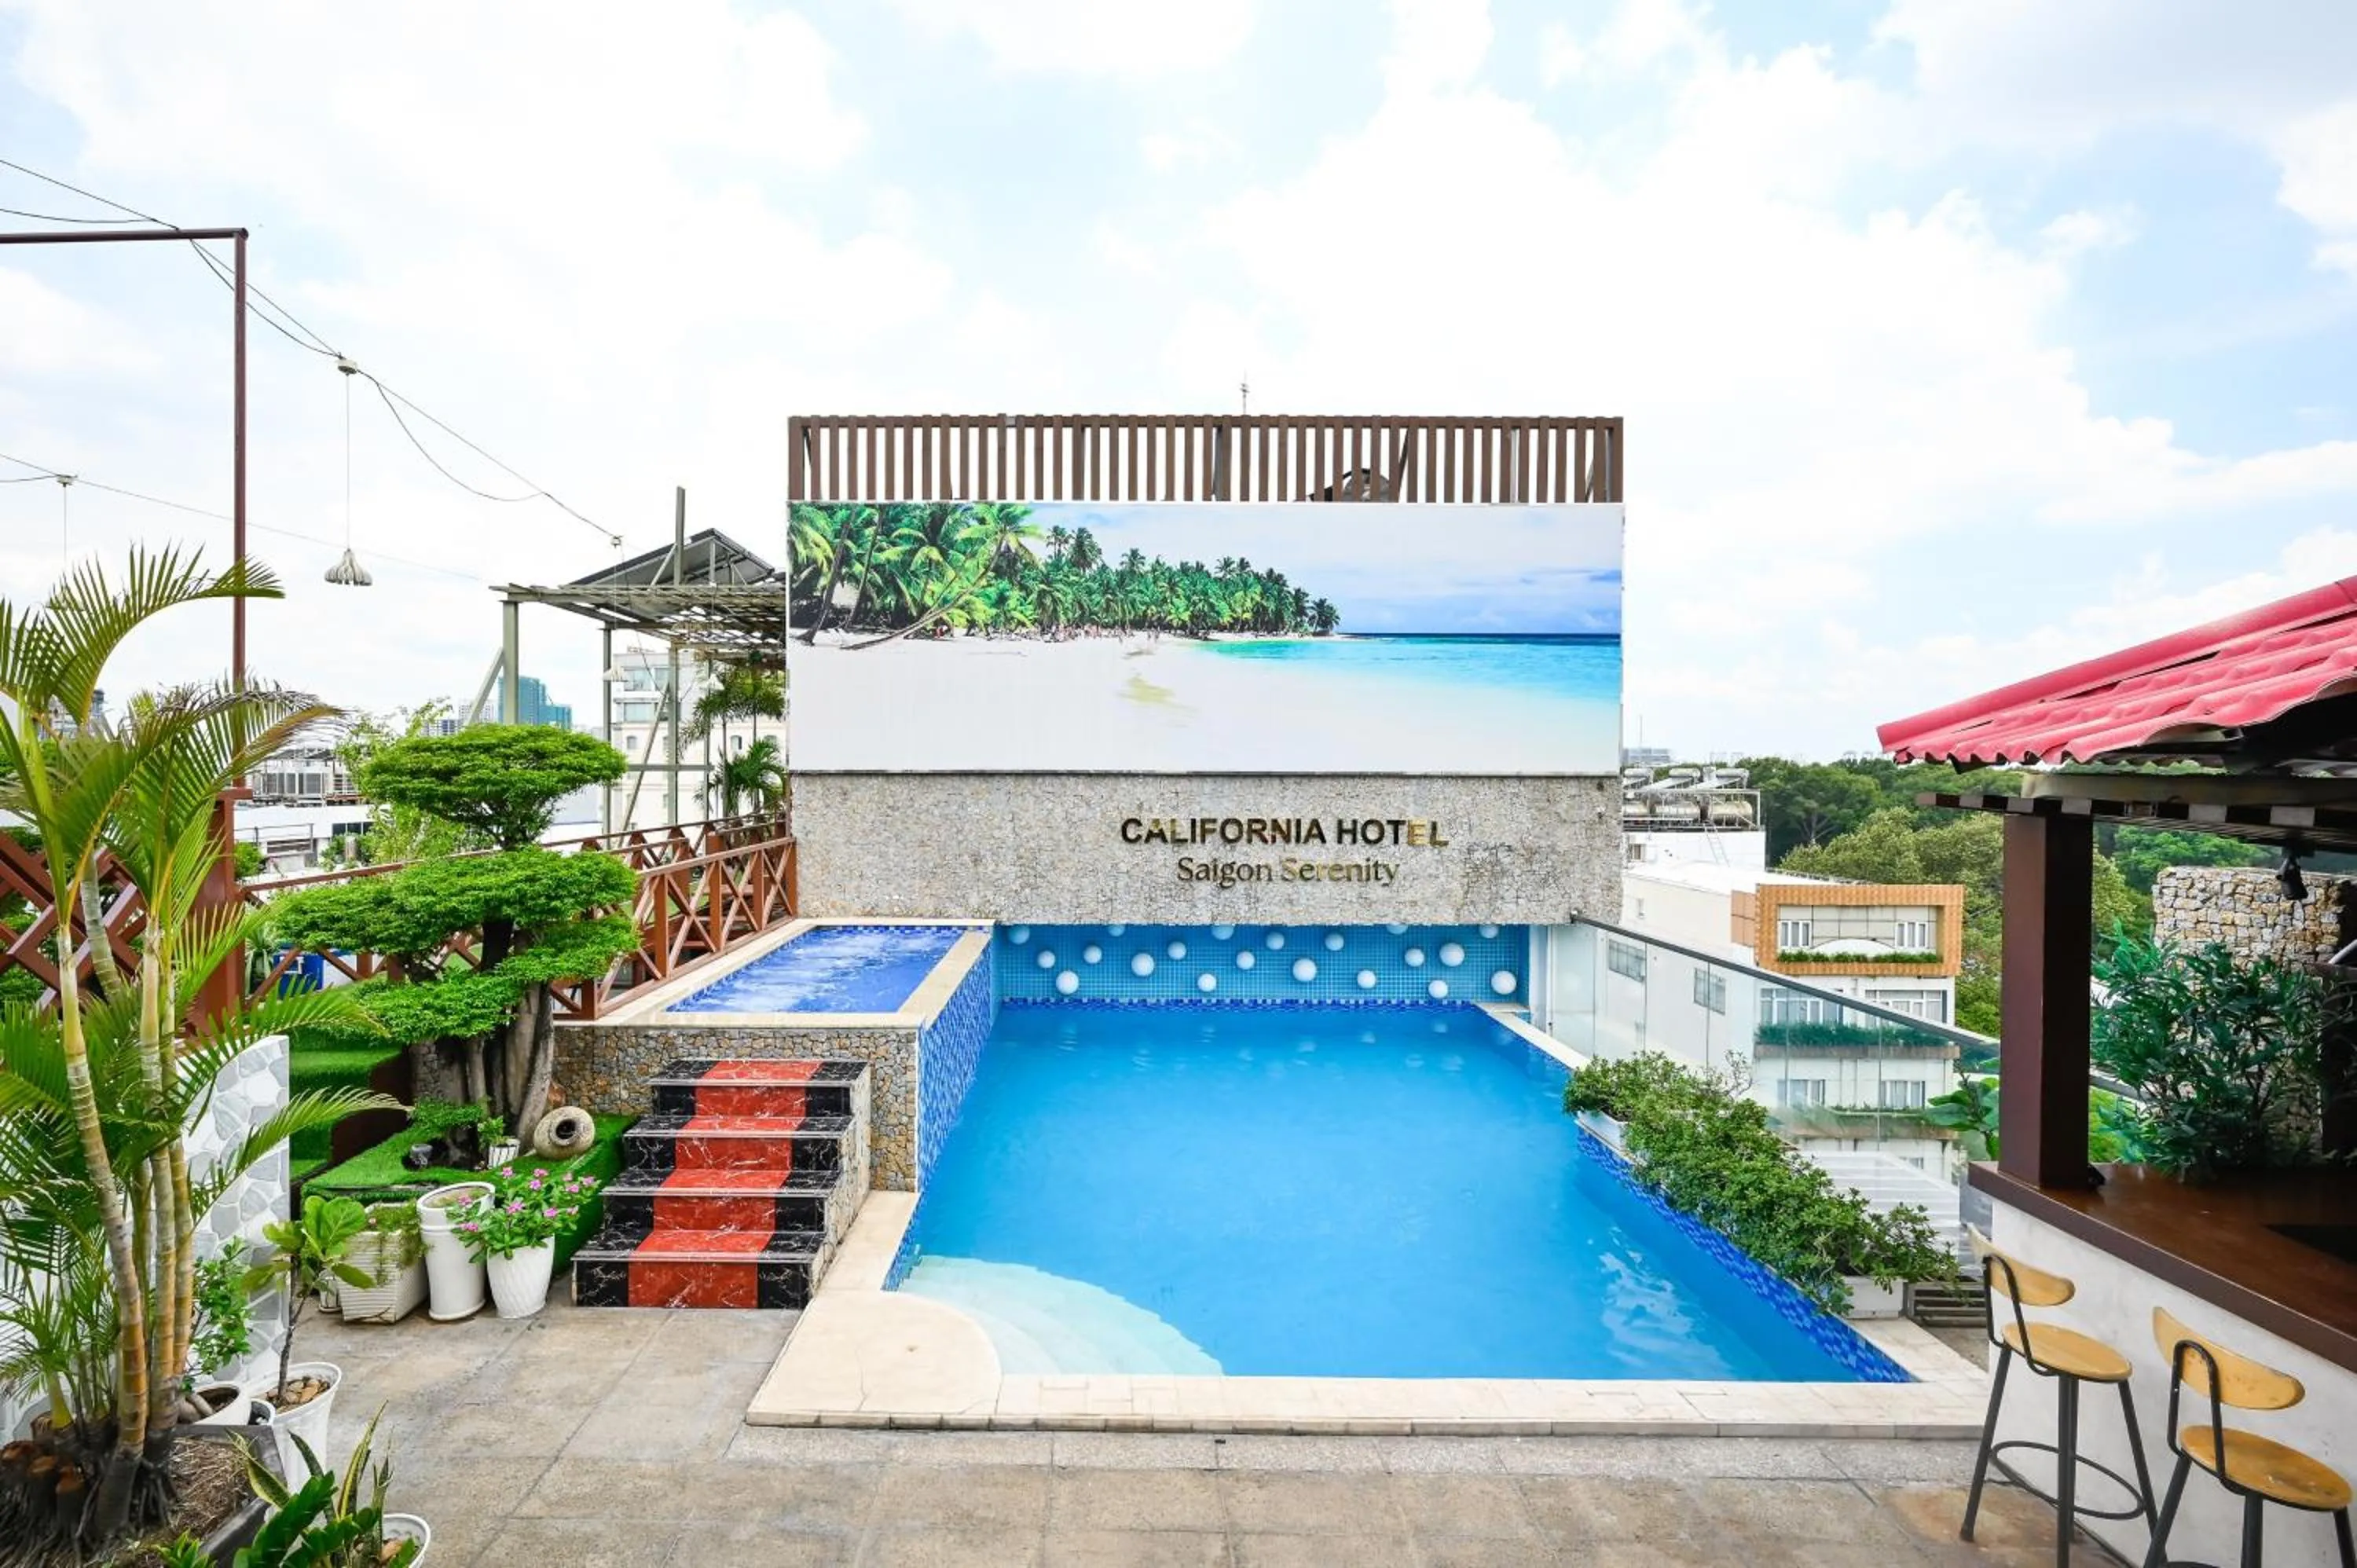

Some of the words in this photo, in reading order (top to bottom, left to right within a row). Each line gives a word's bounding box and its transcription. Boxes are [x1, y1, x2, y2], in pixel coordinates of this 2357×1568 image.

[1120, 818, 1327, 845] CALIFORNIA
[1337, 819, 1450, 847] HOTEL
[1178, 857, 1273, 888] Saigon
[1281, 858, 1399, 887] Serenity
